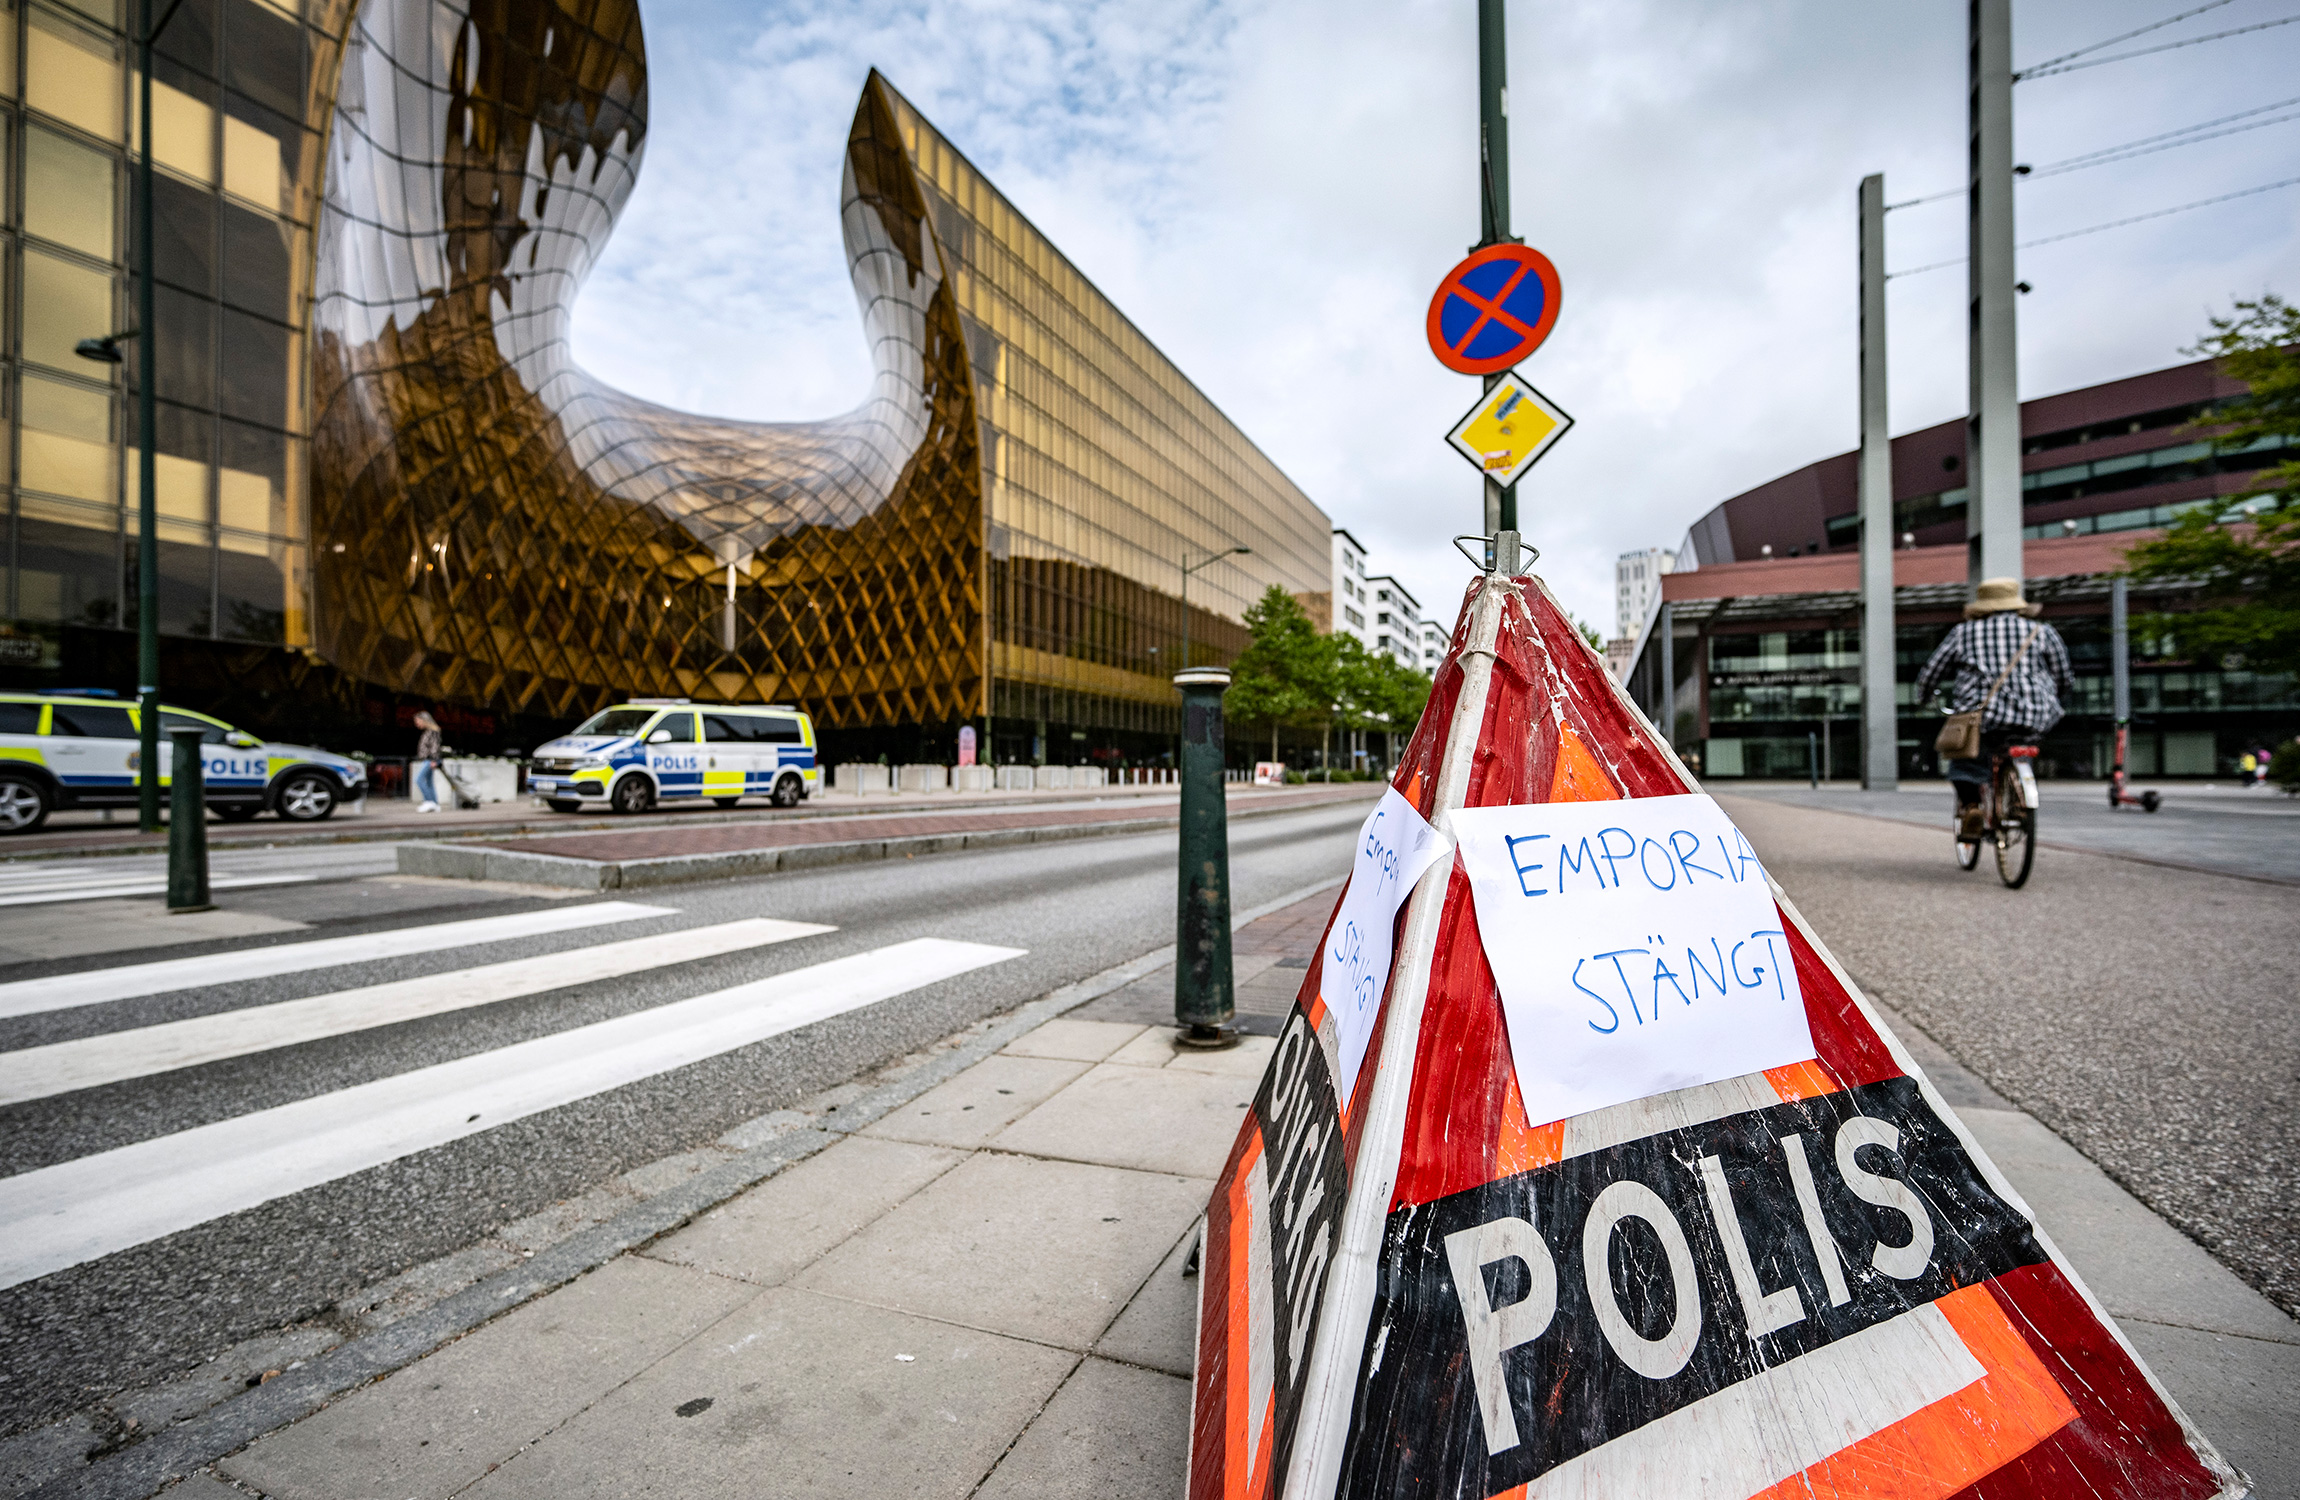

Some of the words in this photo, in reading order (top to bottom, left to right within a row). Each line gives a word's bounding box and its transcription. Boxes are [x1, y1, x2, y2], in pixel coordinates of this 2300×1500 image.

[653, 756, 697, 769] POLIS
[1504, 827, 1767, 897] EMPORIA
[1572, 930, 1785, 1035] STÄNGT
[1444, 1116, 1934, 1456] POLIS
